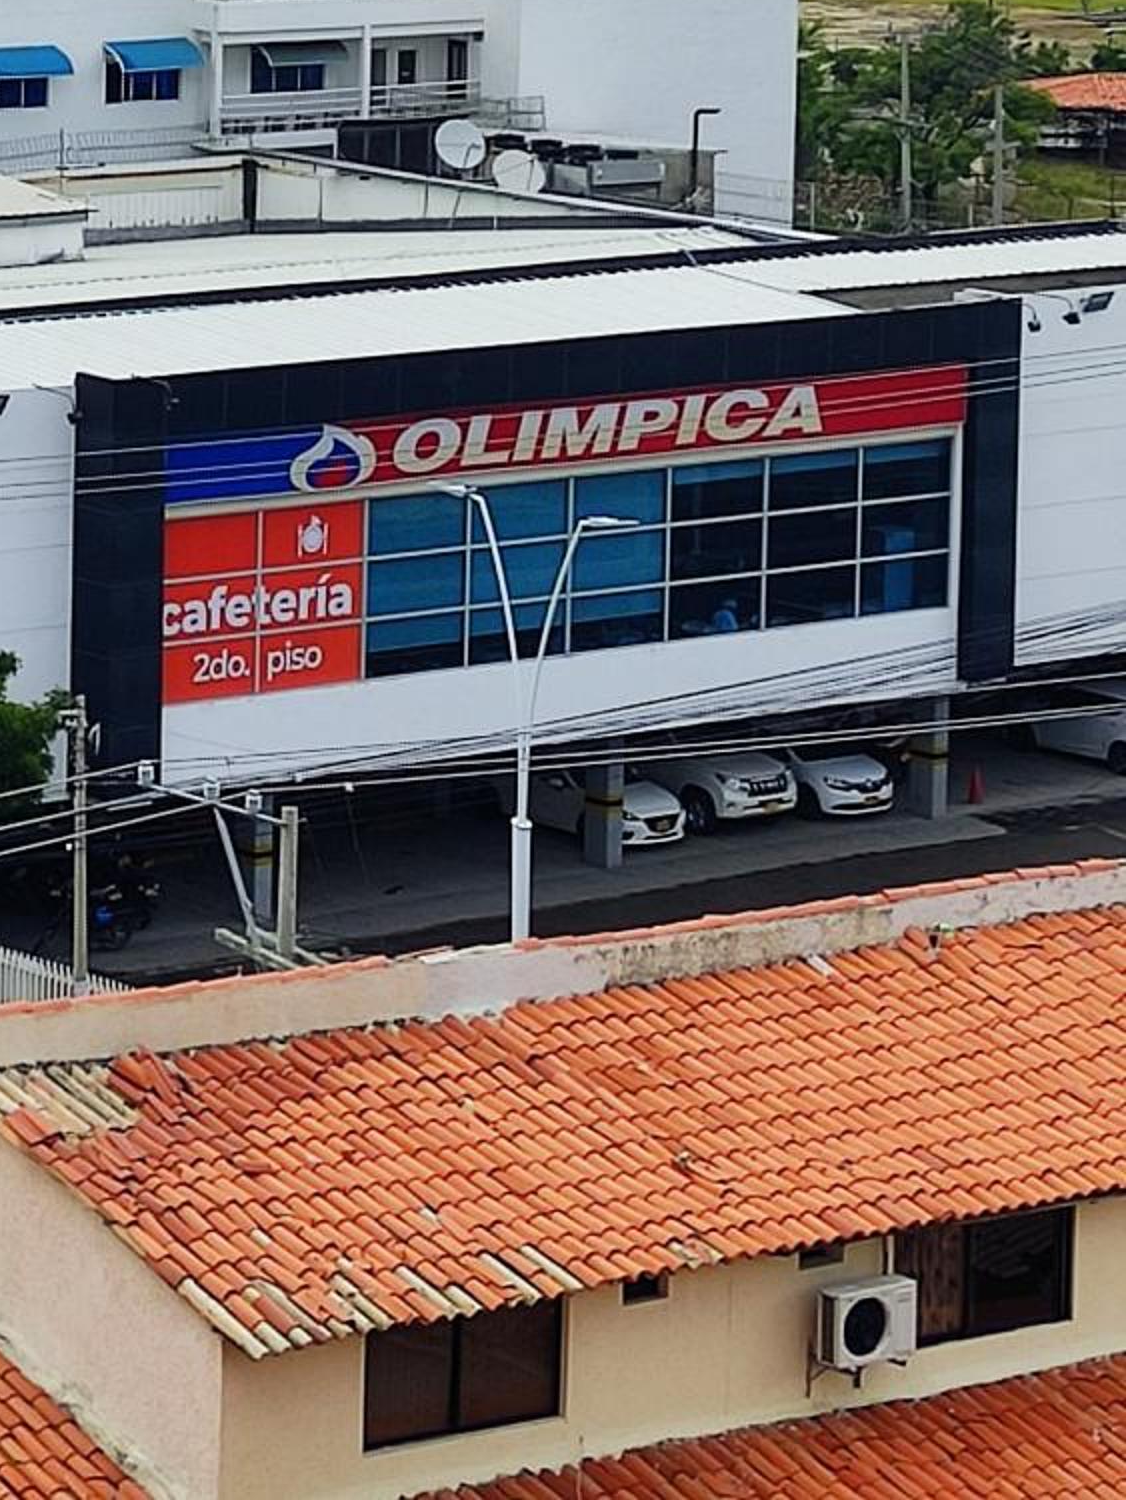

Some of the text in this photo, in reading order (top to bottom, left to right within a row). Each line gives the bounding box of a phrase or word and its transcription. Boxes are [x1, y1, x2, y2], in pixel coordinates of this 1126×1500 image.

[392, 385, 822, 474] OLIMPICA
[162, 573, 353, 637] cafetería
[192, 640, 322, 682] 2do. piso
